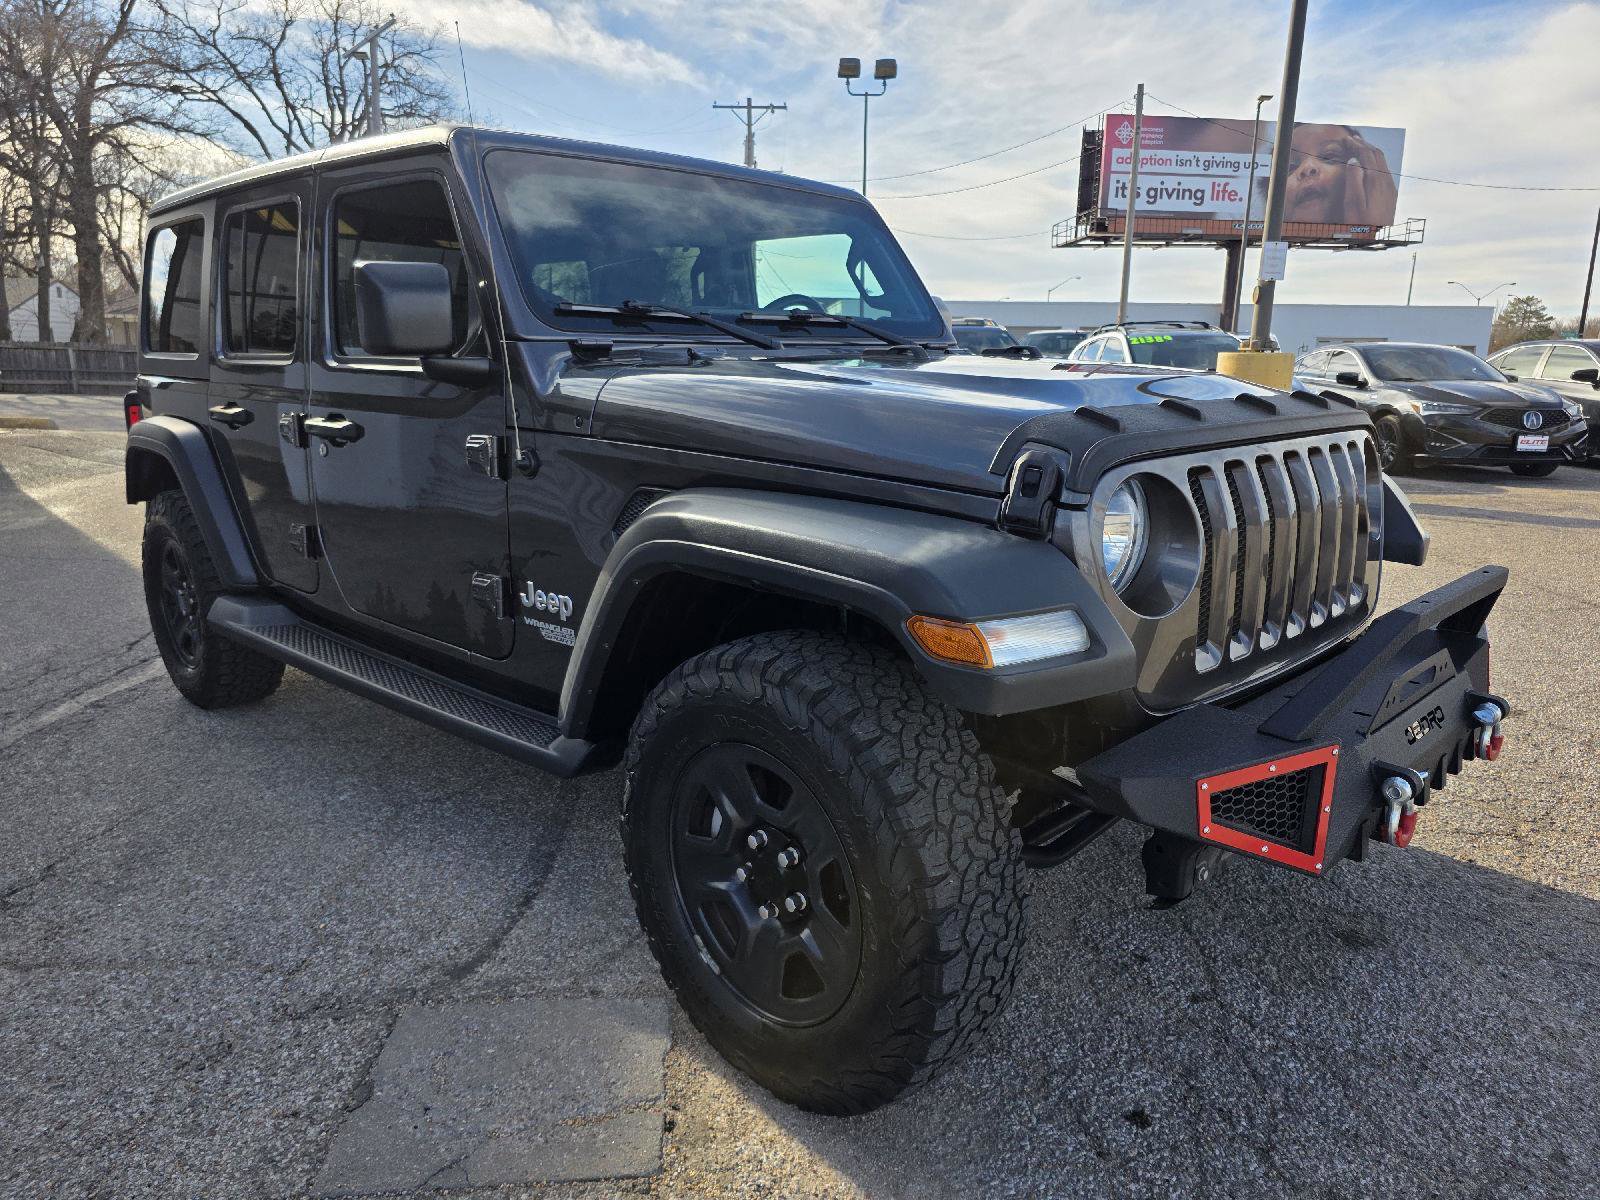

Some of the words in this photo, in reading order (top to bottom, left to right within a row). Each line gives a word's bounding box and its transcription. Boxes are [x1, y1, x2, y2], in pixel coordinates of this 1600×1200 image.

[1116, 153, 1172, 168] adption
[1175, 155, 1200, 167] isn't
[1202, 157, 1240, 172] giving
[1114, 180, 1141, 199] its
[1146, 181, 1205, 206] giving
[1210, 182, 1243, 202] life.
[520, 581, 573, 622] Jeep
